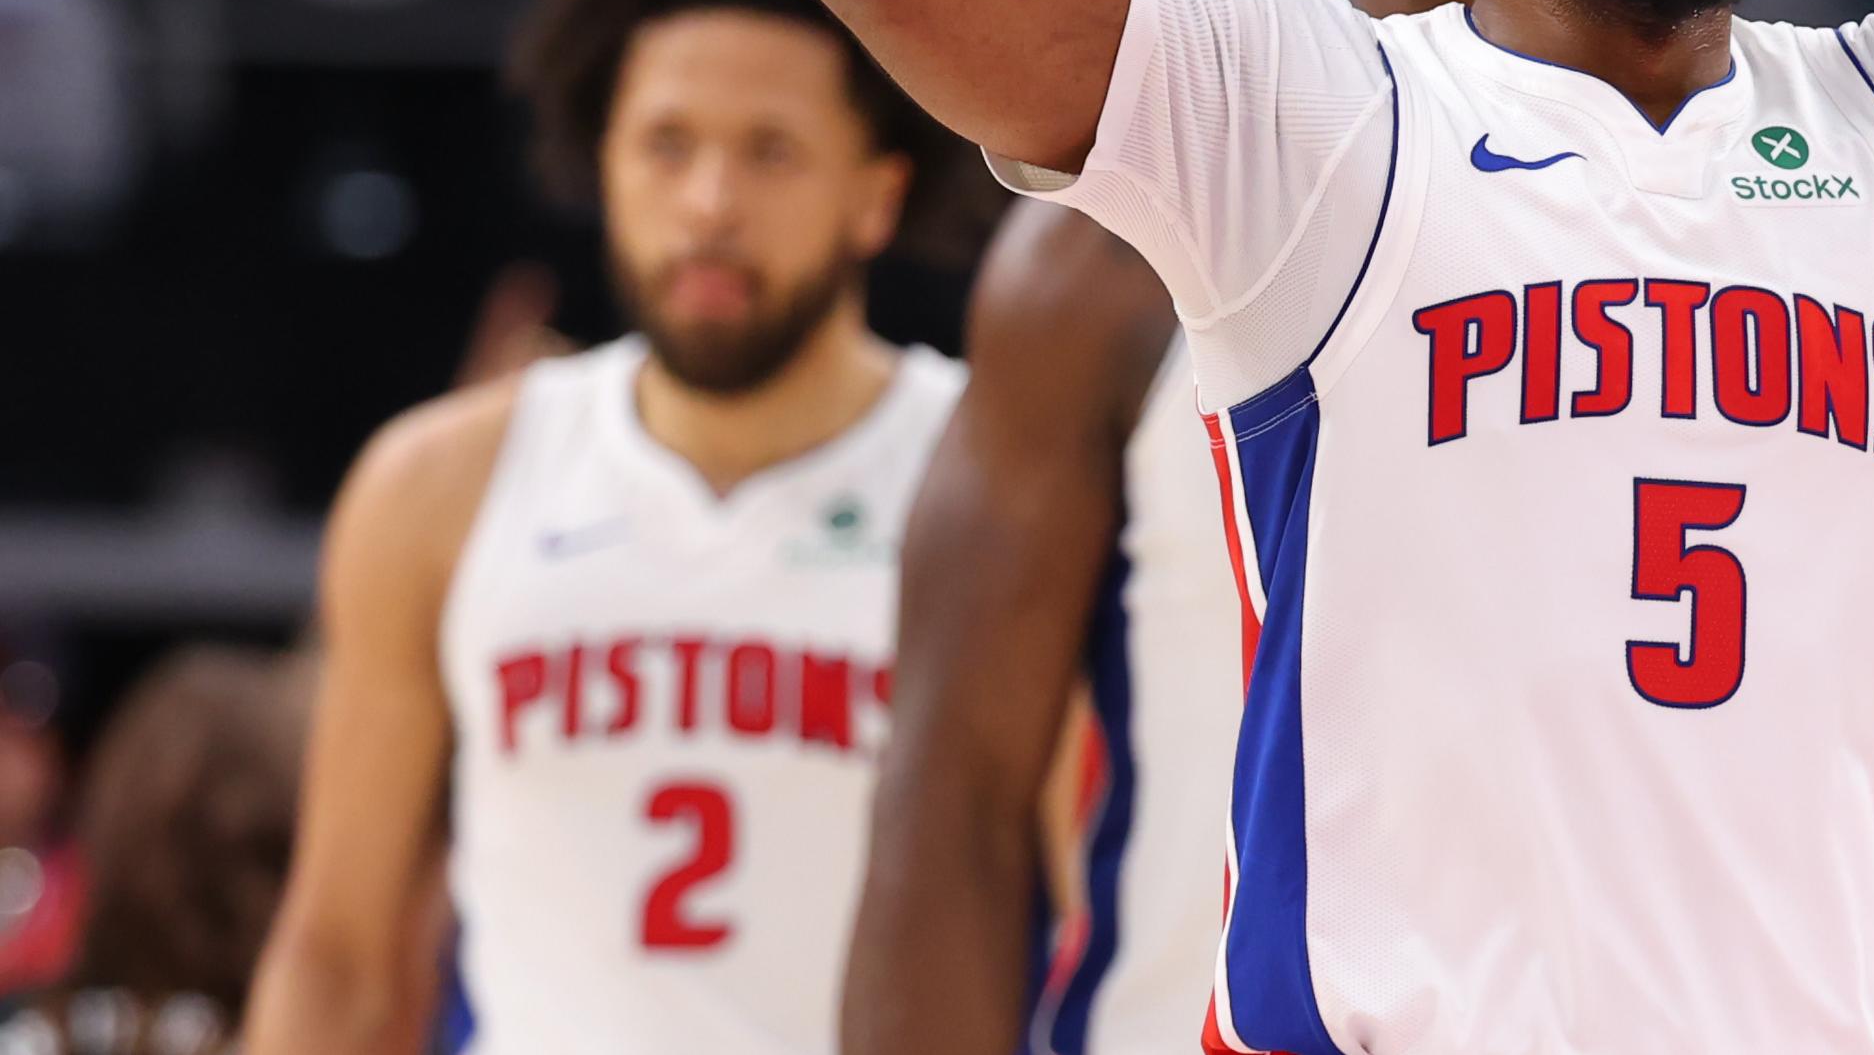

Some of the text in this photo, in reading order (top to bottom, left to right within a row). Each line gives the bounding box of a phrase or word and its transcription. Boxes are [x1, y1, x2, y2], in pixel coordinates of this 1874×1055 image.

[1730, 174, 1861, 200] StockX
[1625, 477, 1747, 710] 5
[638, 776, 739, 952] 2
